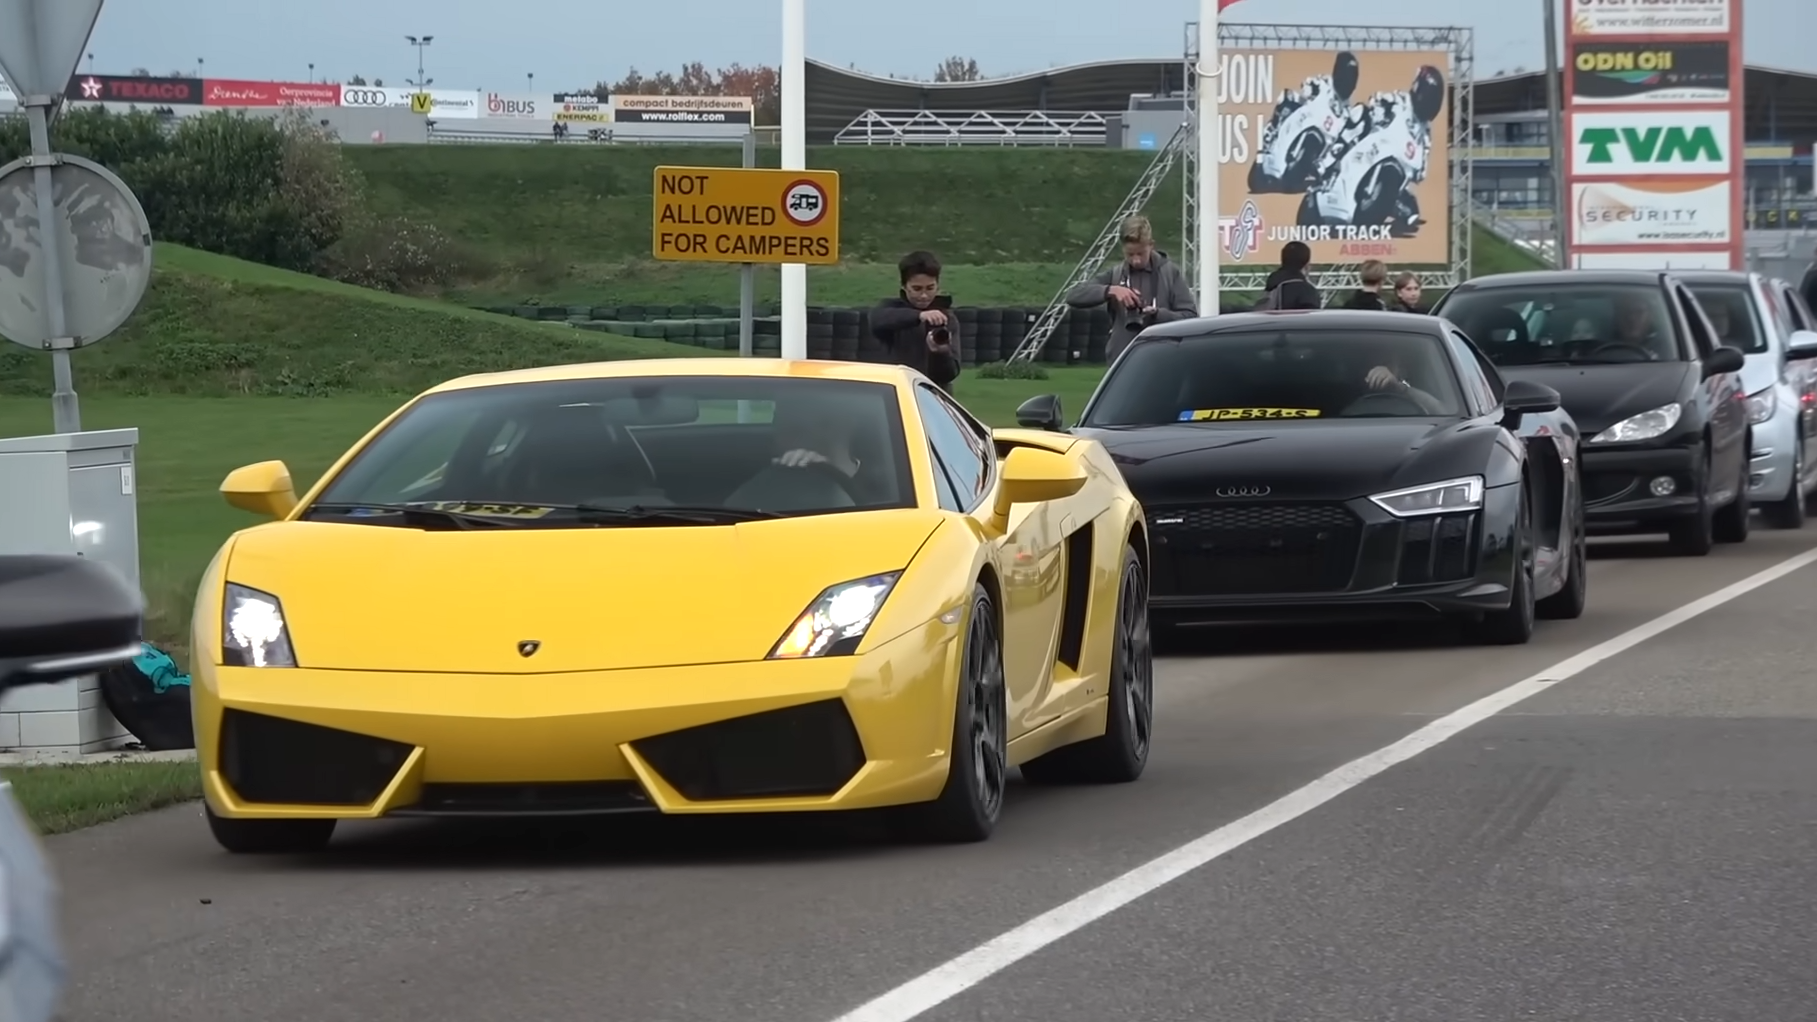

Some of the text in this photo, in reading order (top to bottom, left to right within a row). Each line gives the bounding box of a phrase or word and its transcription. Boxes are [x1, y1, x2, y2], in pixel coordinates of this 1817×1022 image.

[1575, 51, 1673, 71] ODN Oil
[1217, 54, 1274, 104] JOIN
[110, 81, 190, 99] TEXACO
[416, 95, 428, 110] V
[507, 101, 535, 114] BUS
[564, 95, 598, 104] metabo
[623, 98, 743, 110] compact bedrijfsdeuren
[556, 113, 598, 122] ENERPAC
[641, 111, 725, 121] www.rolflex.com
[1217, 114, 1249, 164] US
[1578, 126, 1723, 163] TVM
[661, 175, 709, 195] NOT
[660, 204, 776, 226] ALLOWED
[1586, 209, 1698, 222] SECURITY
[1267, 224, 1392, 240] JUNIOR TRACK
[660, 233, 830, 256] FOR CAMPERS
